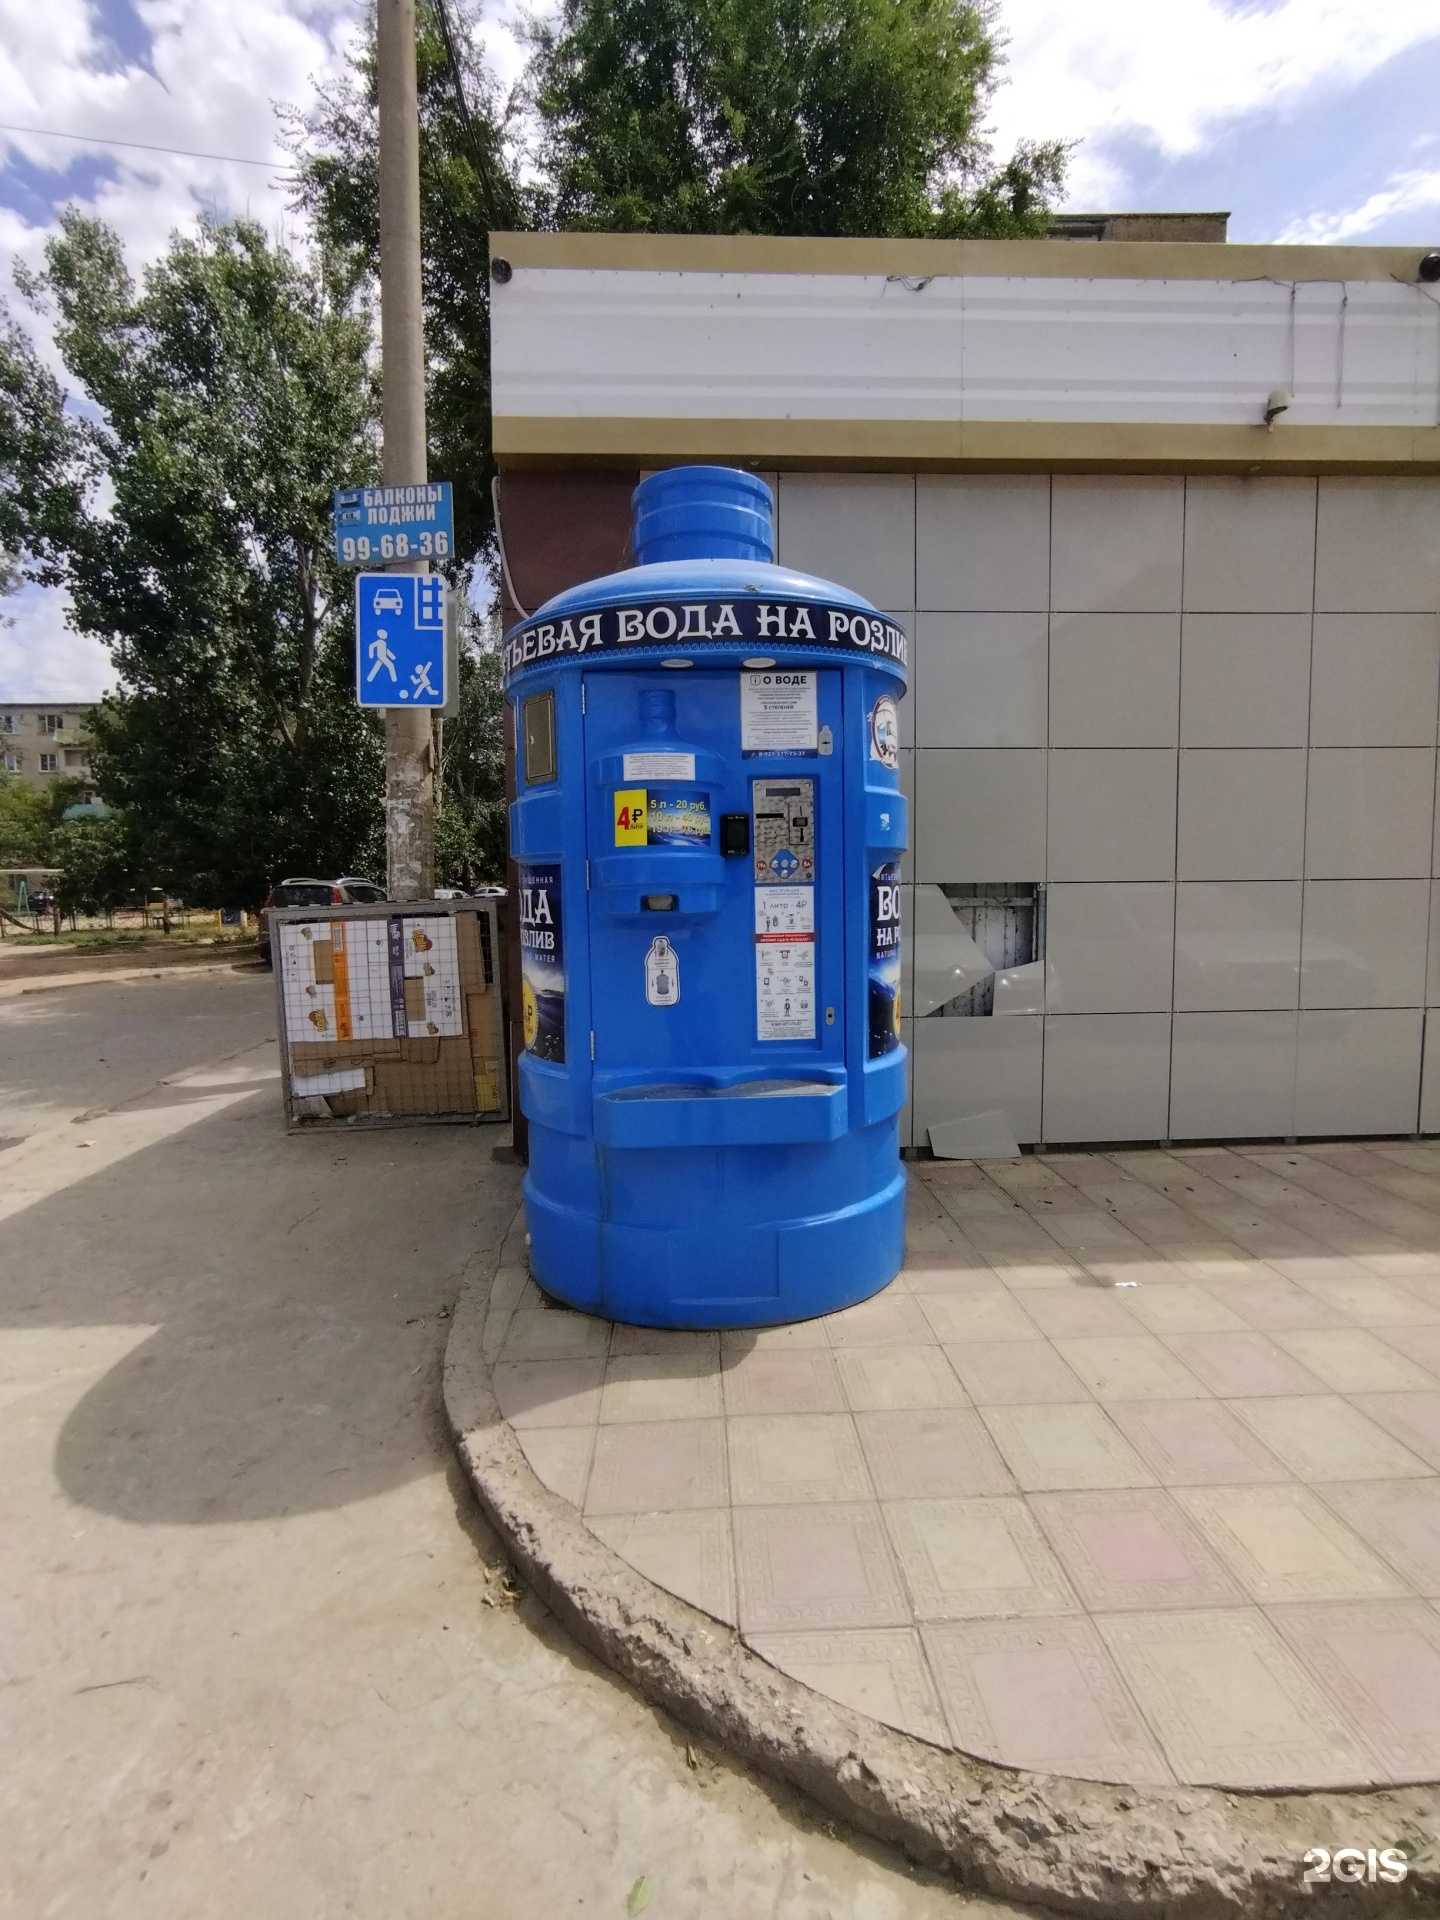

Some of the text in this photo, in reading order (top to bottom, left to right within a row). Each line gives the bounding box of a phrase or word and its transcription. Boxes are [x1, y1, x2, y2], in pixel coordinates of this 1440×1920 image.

[363, 485, 443, 507] БАЛКОНЫ
[367, 504, 436, 526] ЛОДЖИИ
[342, 531, 449, 562] 99-68-36
[616, 604, 743, 642] ВОДА
[756, 605, 817, 640] НА
[763, 675, 807, 686] О ВОДЕ
[650, 800, 657, 809] 5
[676, 800, 688, 809] 20
[519, 889, 554, 927] ДА
